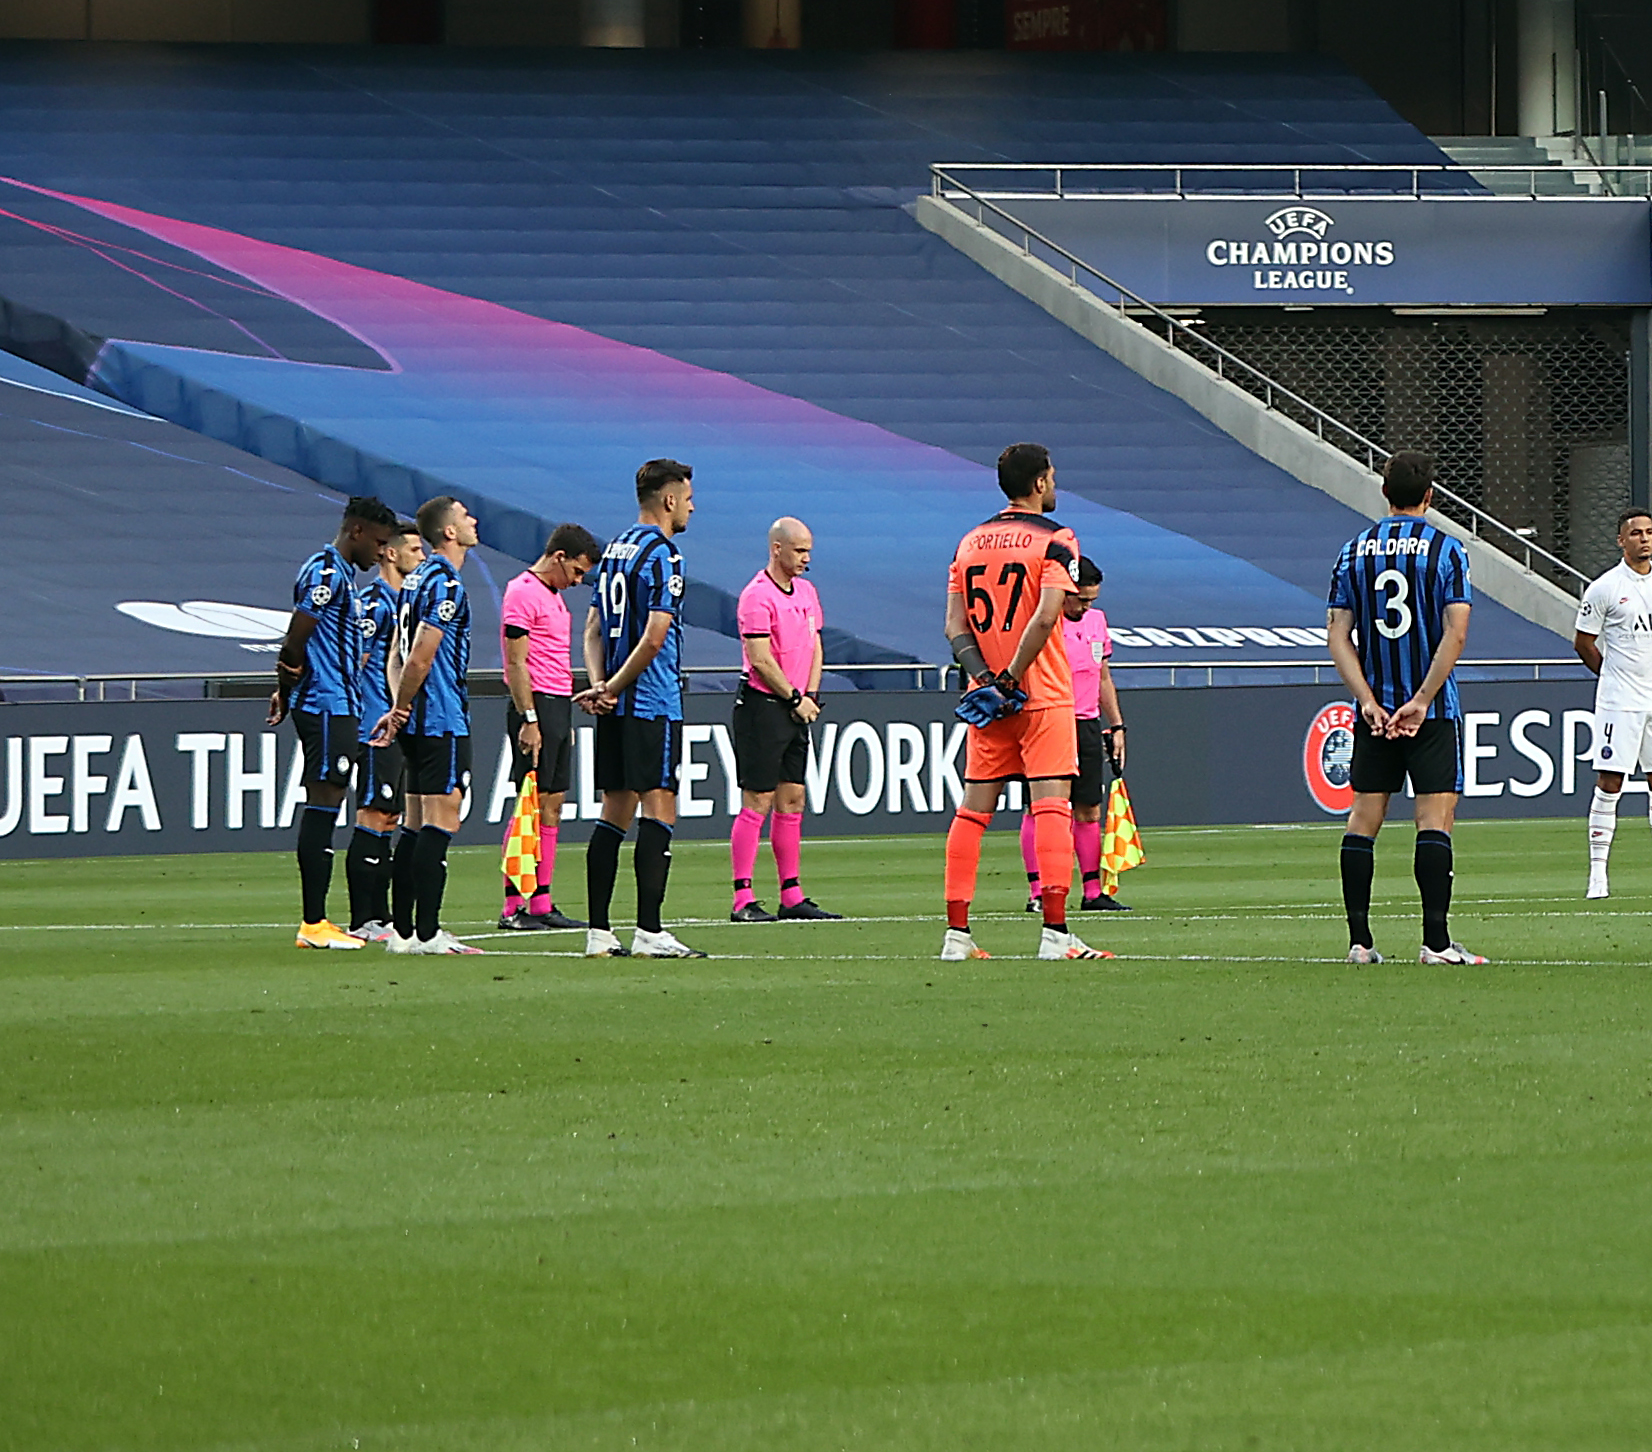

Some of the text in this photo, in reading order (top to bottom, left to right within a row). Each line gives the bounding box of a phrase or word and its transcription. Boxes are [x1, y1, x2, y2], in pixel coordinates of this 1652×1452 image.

[1269, 212, 1328, 236] UEFA
[1206, 240, 1395, 265] CHAMPIONS
[1254, 271, 1348, 289] LEAGUE
[967, 533, 1032, 552] SPORTIELLO
[1356, 537, 1430, 557] CALDARA
[598, 572, 626, 638] 19
[966, 562, 1027, 633] 57
[1374, 569, 1412, 639] 3
[1107, 627, 1358, 647] GAZPRO
[1604, 722, 1614, 744] 4
